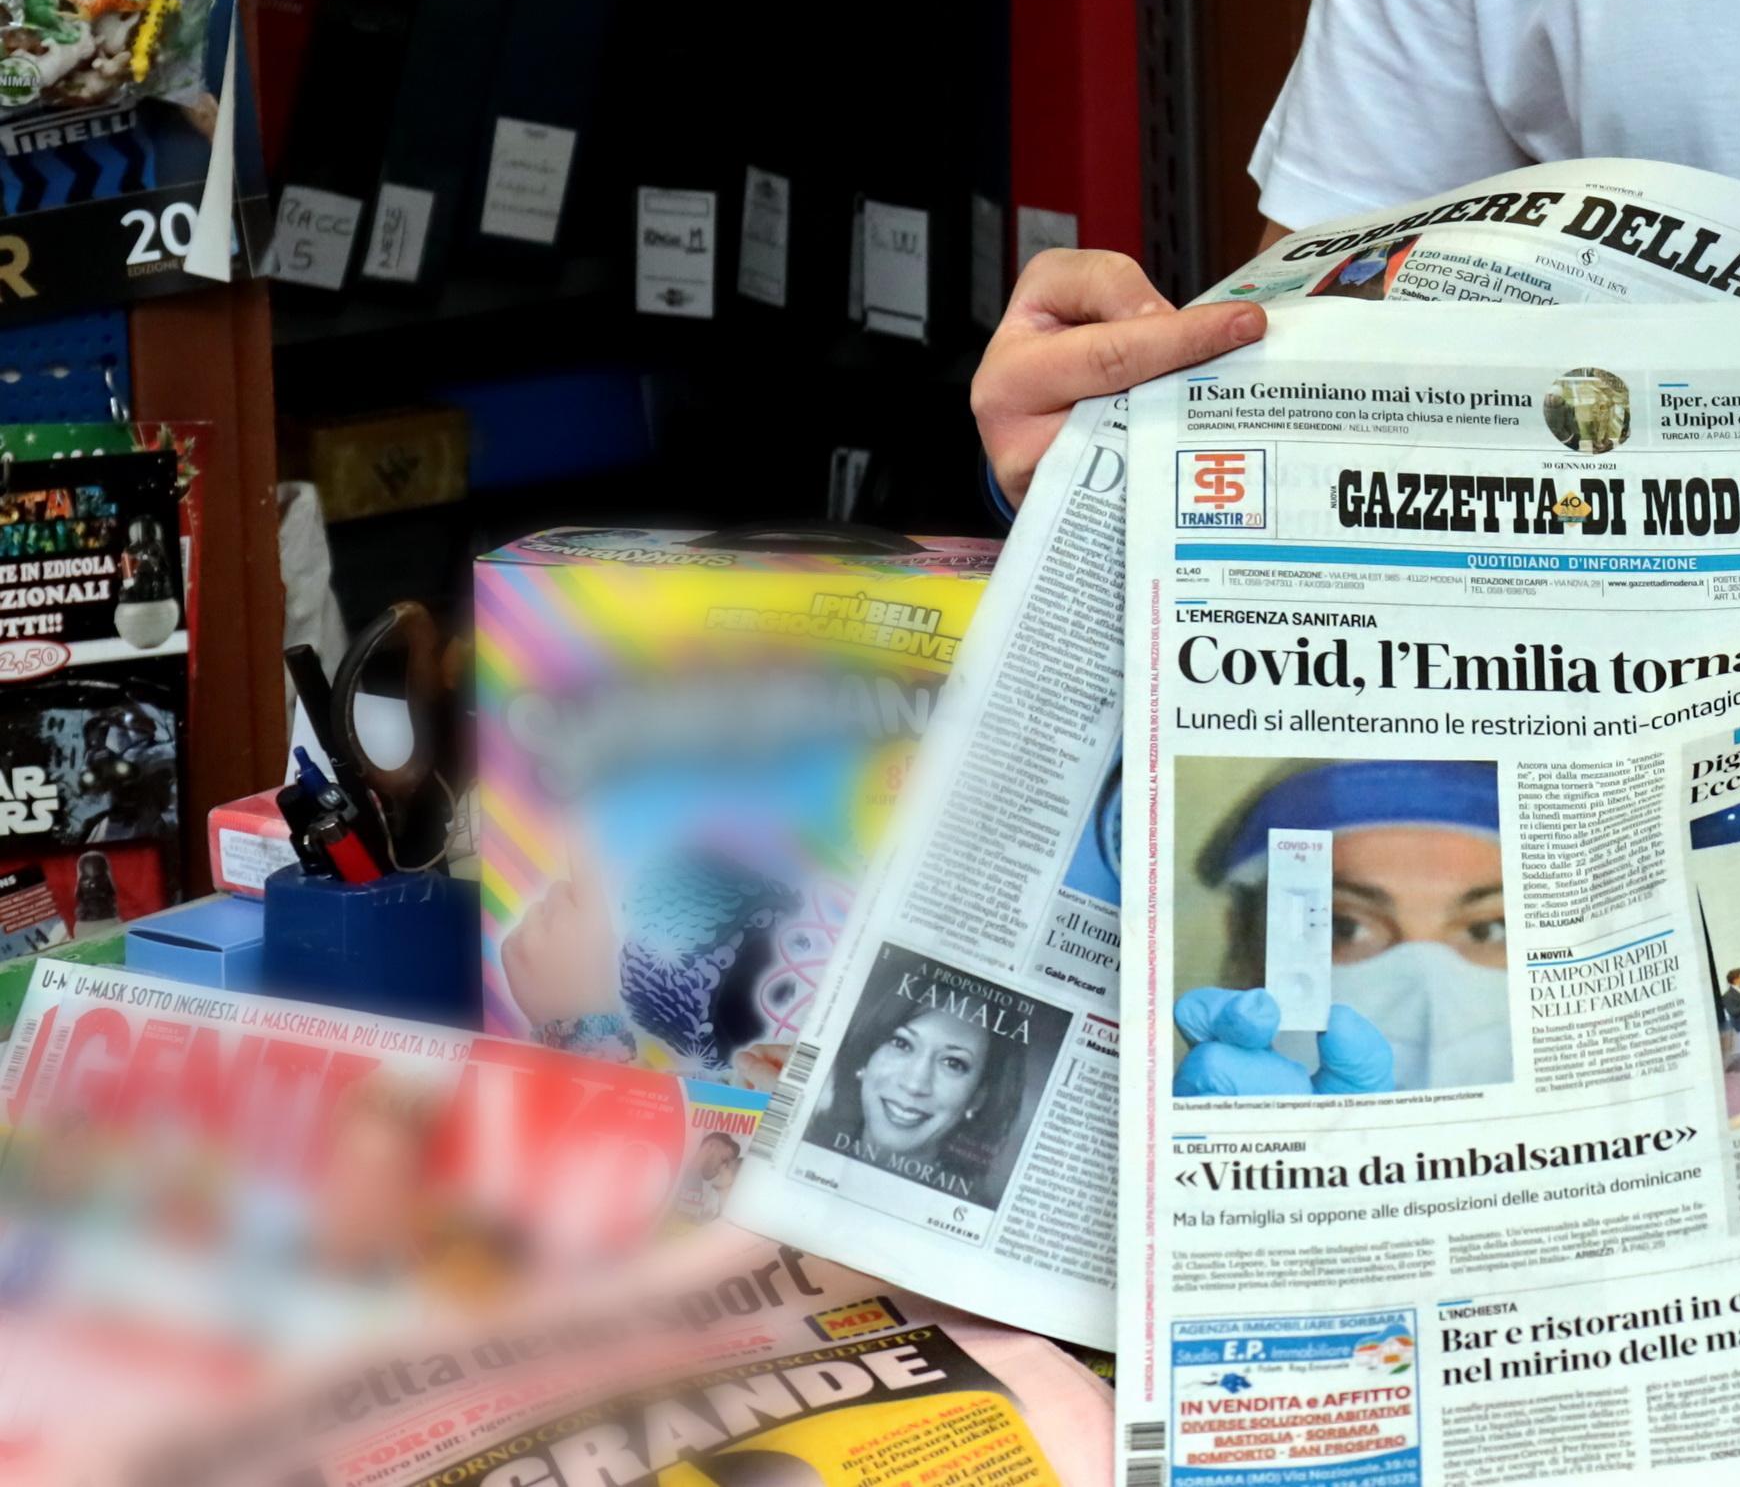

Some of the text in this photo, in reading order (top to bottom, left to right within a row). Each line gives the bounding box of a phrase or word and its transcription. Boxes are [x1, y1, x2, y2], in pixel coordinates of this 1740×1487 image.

[1282, 192, 1565, 262] CORRIERE
[1404, 259, 1453, 278] Come
[1207, 383, 1532, 410] San Geminiano mai visto prima
[1660, 393, 1708, 409] Bper,
[1187, 407, 1333, 423] Domani patrono
[1674, 411, 1735, 430] Unipol
[1338, 469, 1565, 535] GAZZETTA
[1580, 477, 1627, 536] DI
[1181, 511, 1244, 527] TRANSTIR
[20, 555, 115, 581] IN EDICOLA
[1467, 554, 1698, 571] QUOTIDIANO D'INFORMAZIONE
[866, 600, 941, 635] BELLI
[1176, 610, 1377, 628] L'EMERGENZA SANITARIA
[1178, 635, 1366, 696] Covid,
[1176, 707, 1257, 731] Lunedì
[1264, 711, 1283, 732] si
[1290, 711, 1439, 734] allenteranno
[1445, 713, 1465, 734] le
[1471, 714, 1587, 736] restrizioni
[933, 967, 1035, 1016] PROPOSITO DI
[75, 976, 446, 1059] U-MASK SOTTO INCHIESTA LA MASCHERINA PIÙ USATA DA
[896, 972, 1031, 1045] KAMALA
[692, 1106, 756, 1137] UOMINI
[833, 1132, 974, 1197] DAN MORAIN
[1176, 1125, 1698, 1191] «Vittima da imbalsamare»
[1218, 1166, 1702, 1228] famiglia si oppone disposizioni autorità dominicane
[927, 1217, 980, 1241] SOLFERINO
[1439, 1304, 1518, 1321] L'INCHIESTA
[1442, 1325, 1499, 1353] Bar
[1532, 1292, 1683, 1341] ristoranti
[1442, 1358, 1492, 1387] nel
[1500, 1349, 1610, 1381] mirino
[1619, 1332, 1698, 1366] delle
[1208, 1386, 1411, 1414] VENDITA AFFITTO
[1182, 1419, 1246, 1434] DIVERSE
